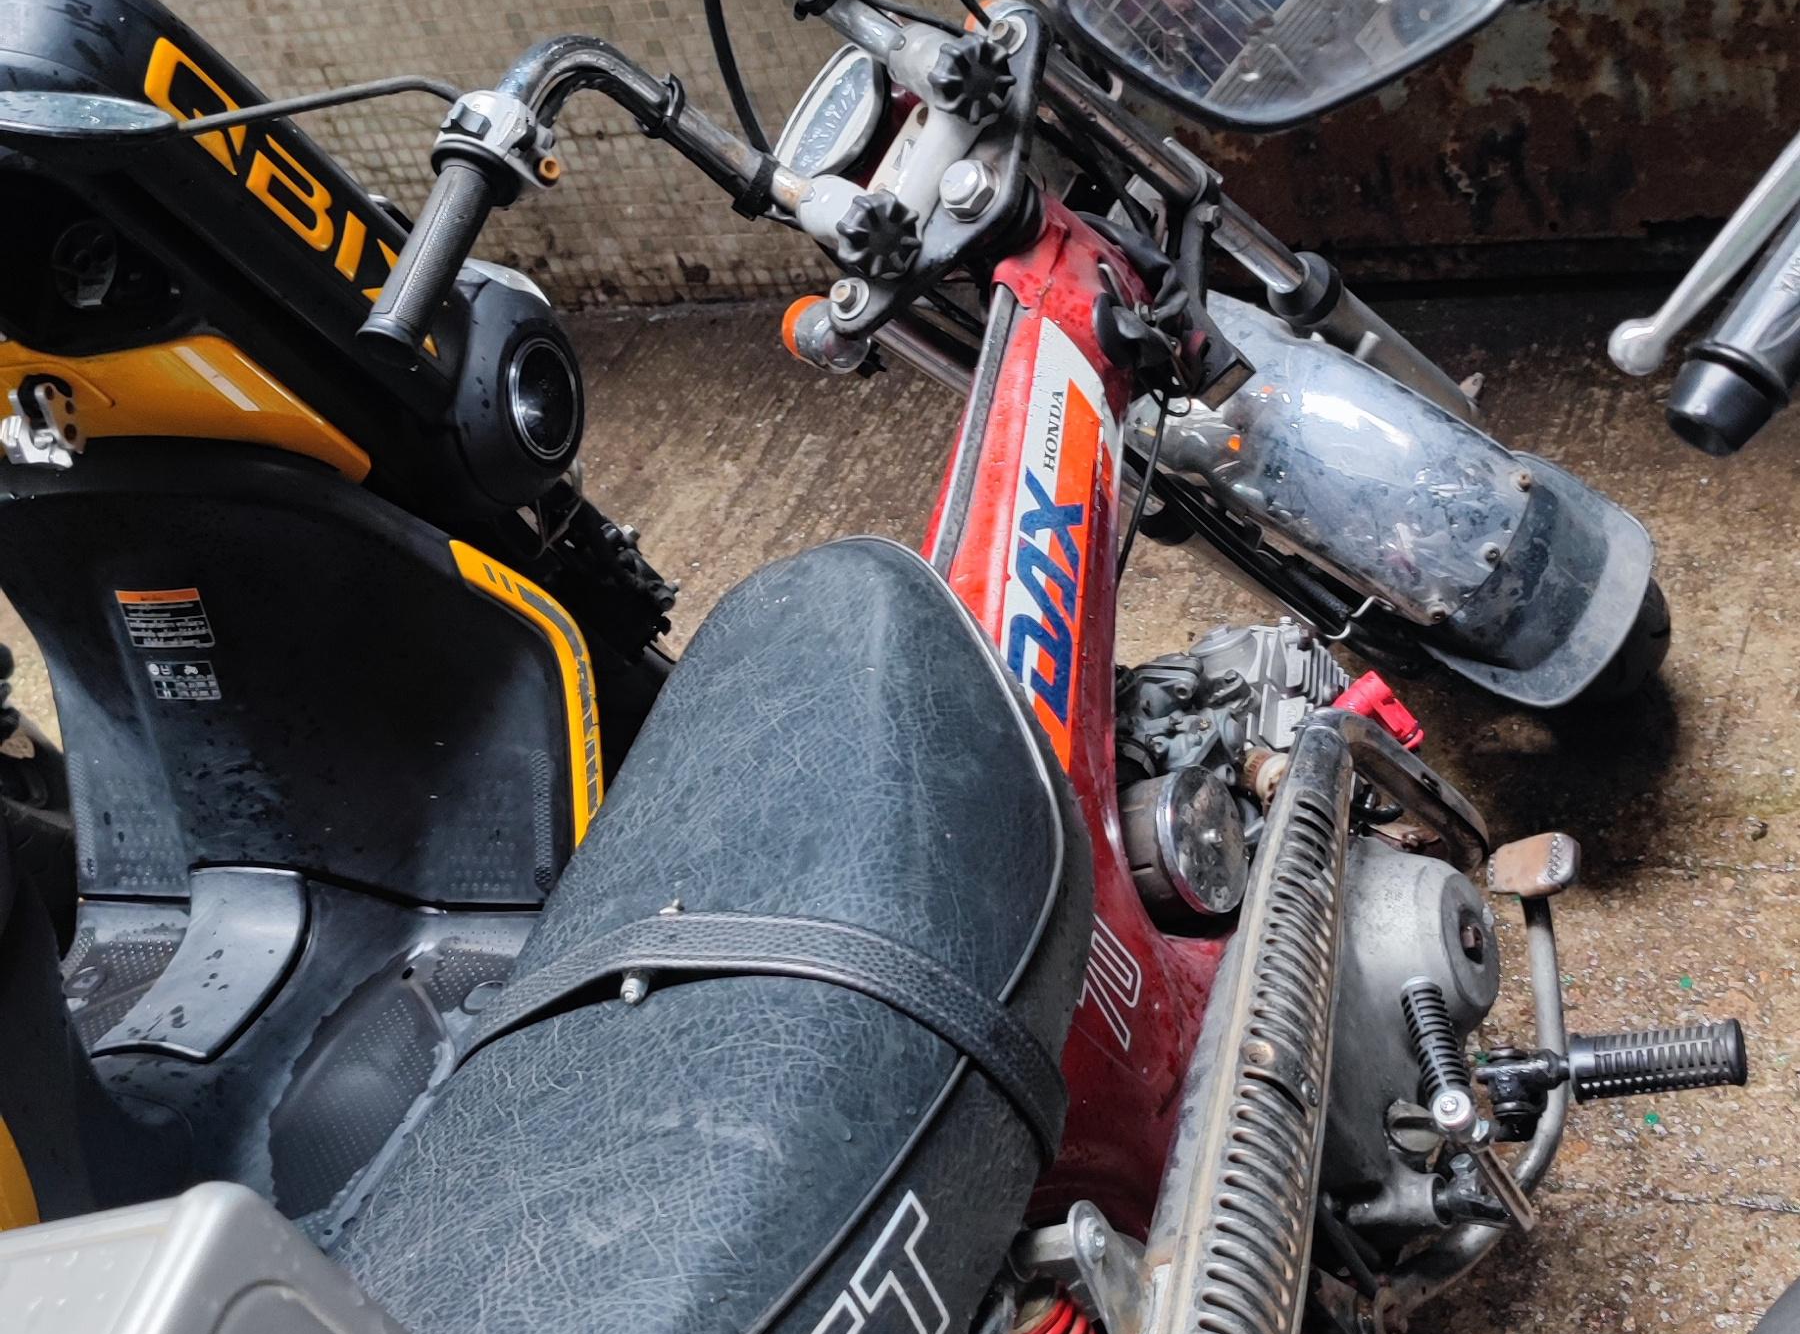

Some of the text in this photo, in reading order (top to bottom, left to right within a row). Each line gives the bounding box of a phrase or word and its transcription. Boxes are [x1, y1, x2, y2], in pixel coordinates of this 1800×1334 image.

[1043, 391, 1065, 473] HONDA
[1007, 465, 1084, 726] DAX
[1076, 912, 1142, 1052] 70
